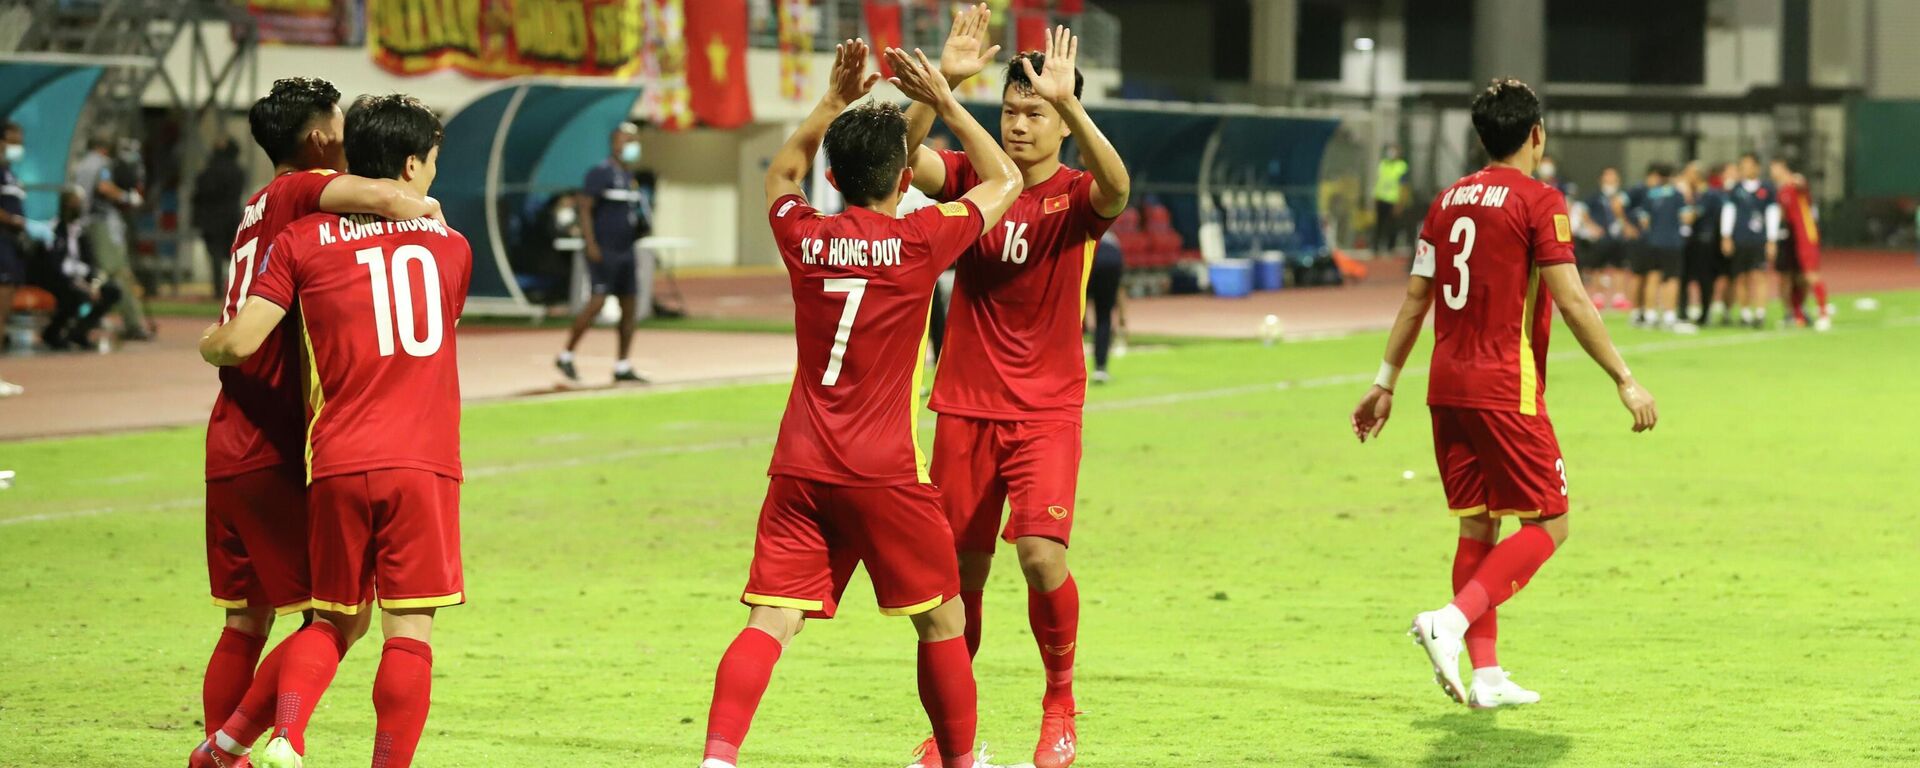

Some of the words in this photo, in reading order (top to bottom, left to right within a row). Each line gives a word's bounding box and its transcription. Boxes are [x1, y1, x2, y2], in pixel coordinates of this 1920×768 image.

[1480, 185, 1510, 208] HAI
[318, 222, 337, 246] N.
[339, 214, 384, 242] CONG
[1001, 220, 1028, 264] 16
[828, 237, 869, 267] HONG
[871, 238, 902, 267] DUY
[1442, 216, 1476, 311] 3
[355, 244, 444, 357] 10
[821, 278, 869, 386] 7
[1555, 458, 1568, 497] 3
